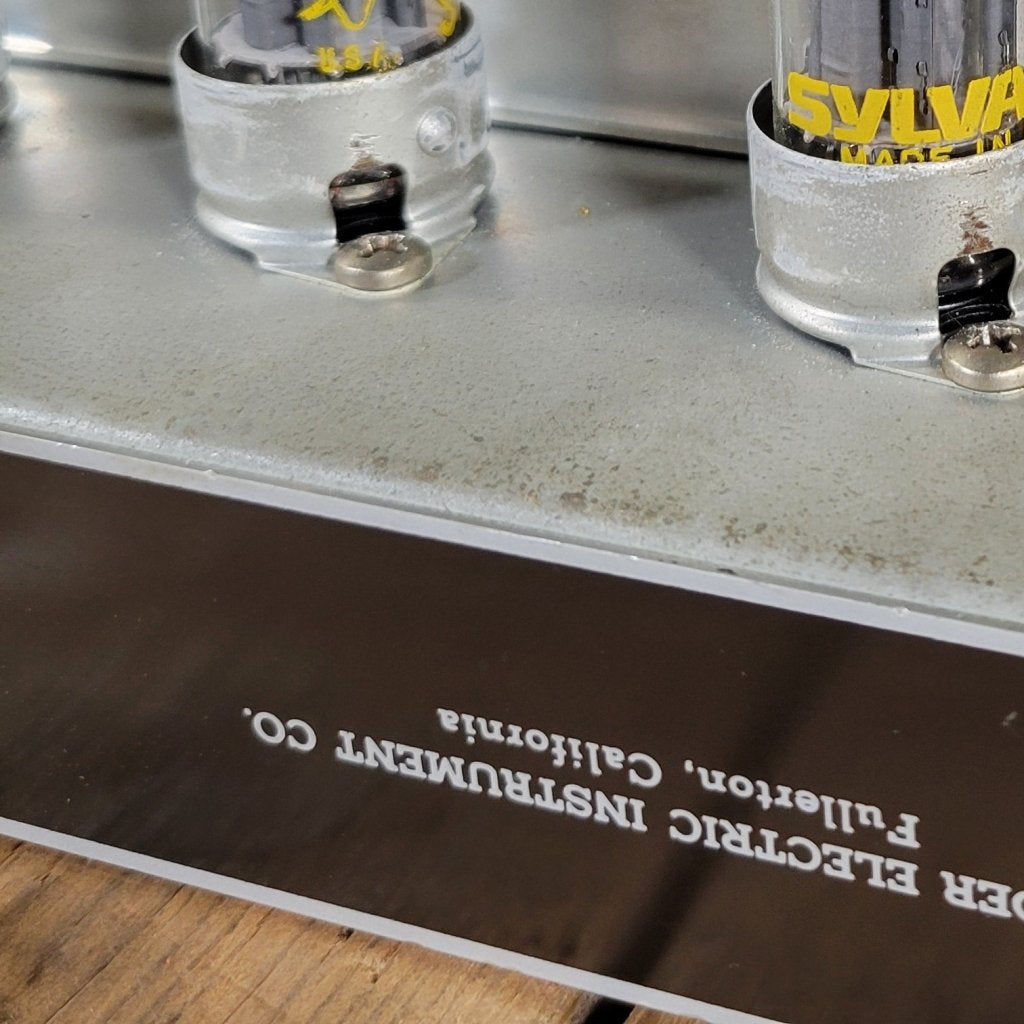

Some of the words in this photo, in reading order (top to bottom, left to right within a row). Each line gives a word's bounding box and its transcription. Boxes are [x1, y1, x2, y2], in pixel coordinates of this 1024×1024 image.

[243, 707, 317, 752] CO.
[437, 708, 662, 788] California
[335, 730, 648, 832] INSTRUMENT
[684, 759, 921, 849] Fullerton,
[669, 807, 920, 896] ELECTRIC
